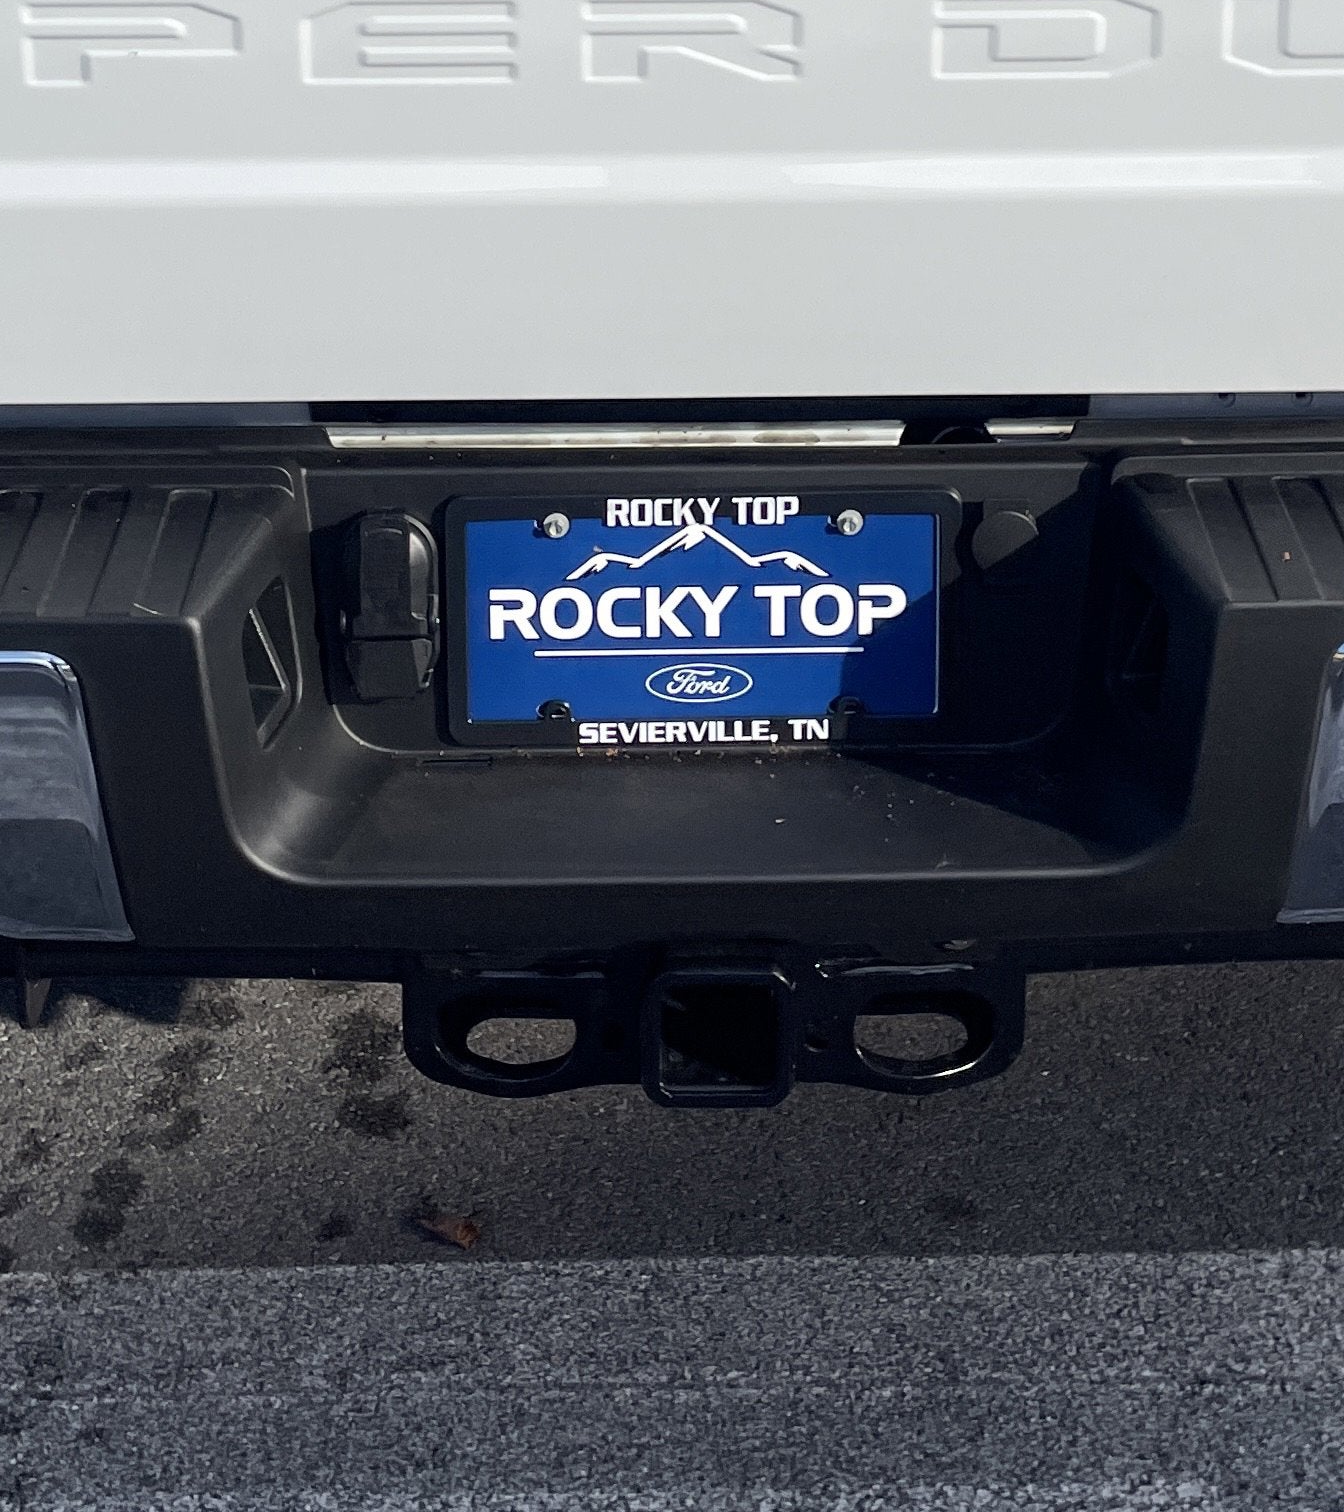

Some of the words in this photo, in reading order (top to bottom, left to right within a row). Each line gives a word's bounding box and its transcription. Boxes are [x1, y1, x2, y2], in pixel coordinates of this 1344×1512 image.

[606, 496, 721, 528] ROCKY
[731, 495, 800, 526] TOP
[488, 585, 740, 640] ROCKY
[753, 583, 908, 637] TOP
[665, 666, 731, 696] Ford
[578, 718, 779, 745] SEVIERVILLE,
[787, 718, 830, 741] TN
